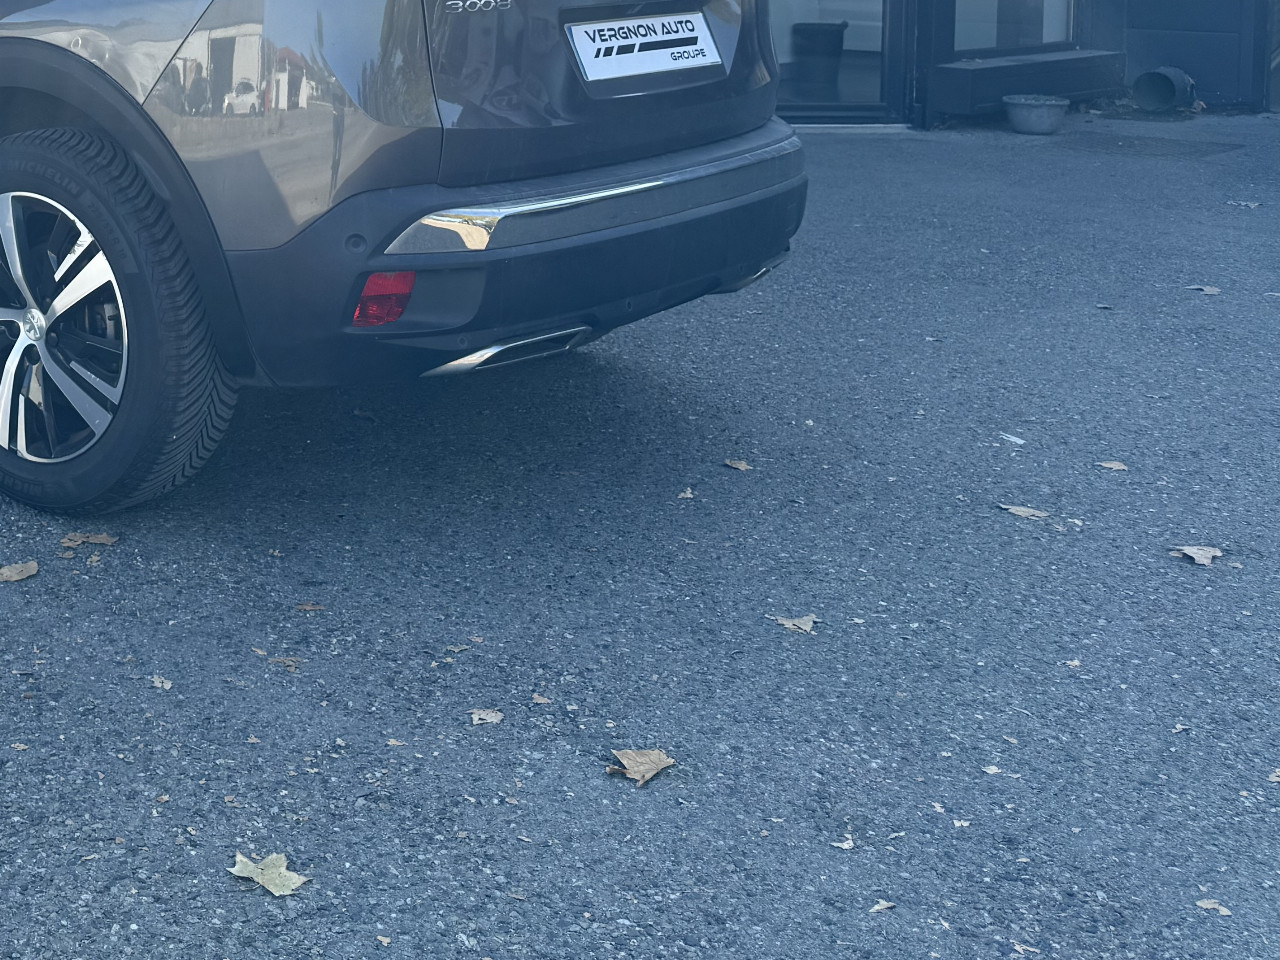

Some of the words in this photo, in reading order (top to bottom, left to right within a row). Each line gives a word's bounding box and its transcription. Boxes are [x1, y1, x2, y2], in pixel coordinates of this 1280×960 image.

[584, 23, 658, 44] VERGNON
[662, 20, 695, 36] AUTO
[671, 48, 707, 61] GROUPE
